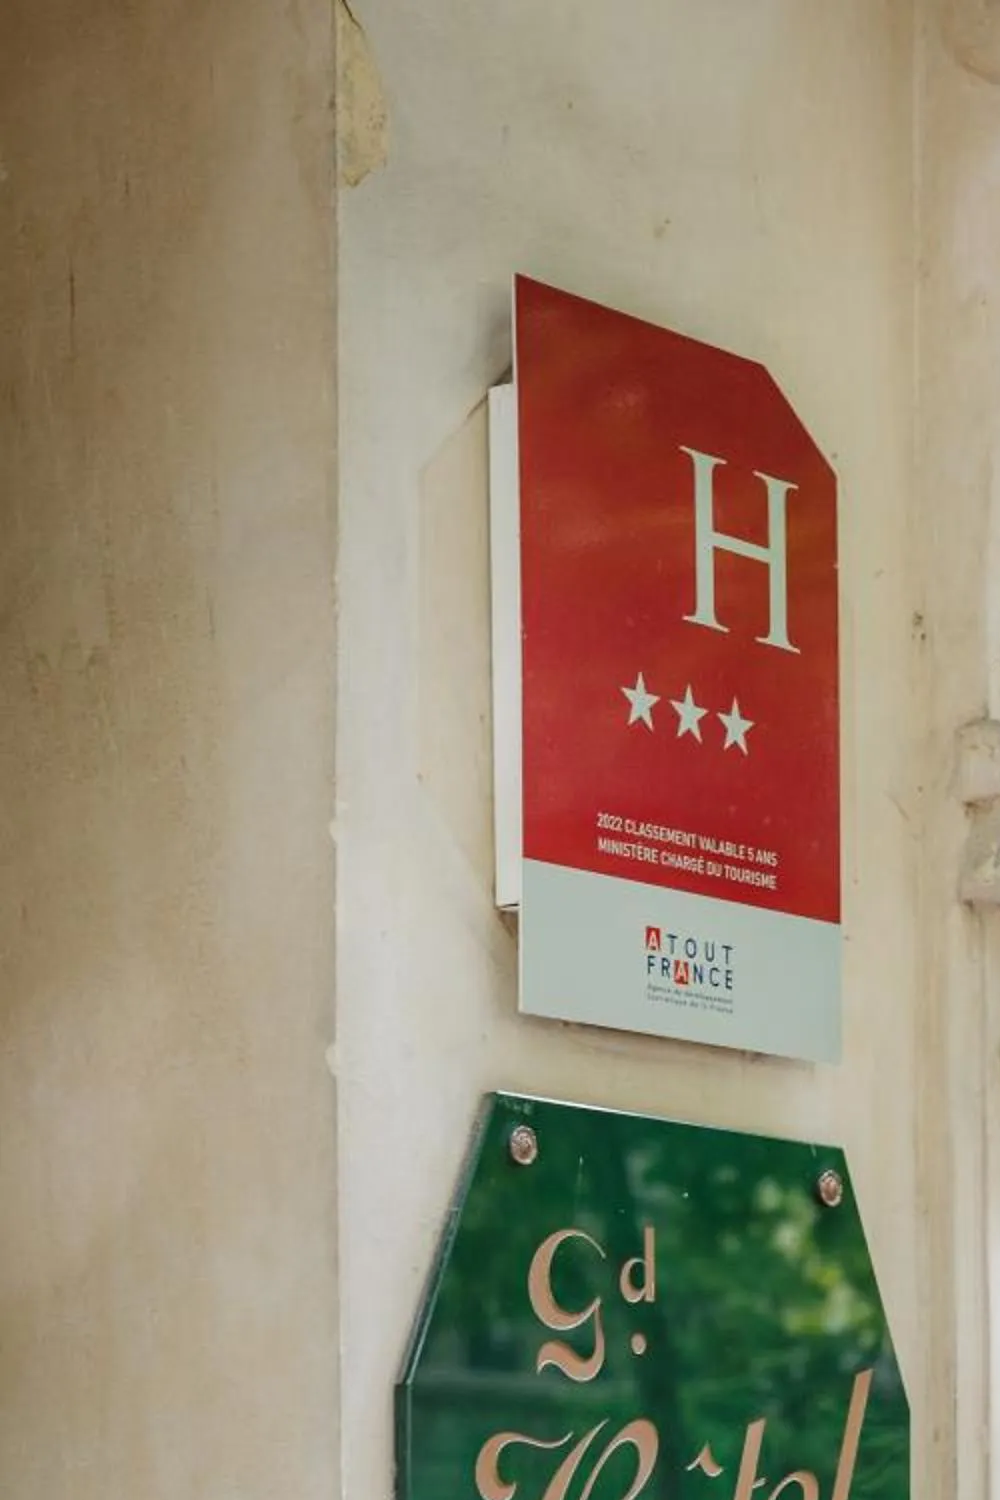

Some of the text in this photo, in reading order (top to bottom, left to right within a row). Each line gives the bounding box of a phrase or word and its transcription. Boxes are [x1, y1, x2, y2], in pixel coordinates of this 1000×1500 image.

[679, 445, 800, 654] H
[597, 812, 778, 867] 2022 CLASSEMENT VALABLE 5 ANS
[597, 837, 659, 864] MINISTÈRE
[706, 861, 722, 877] DU
[723, 864, 777, 890] TOURISME
[645, 926, 733, 965] ATOUT
[647, 955, 734, 991] FRANCE
